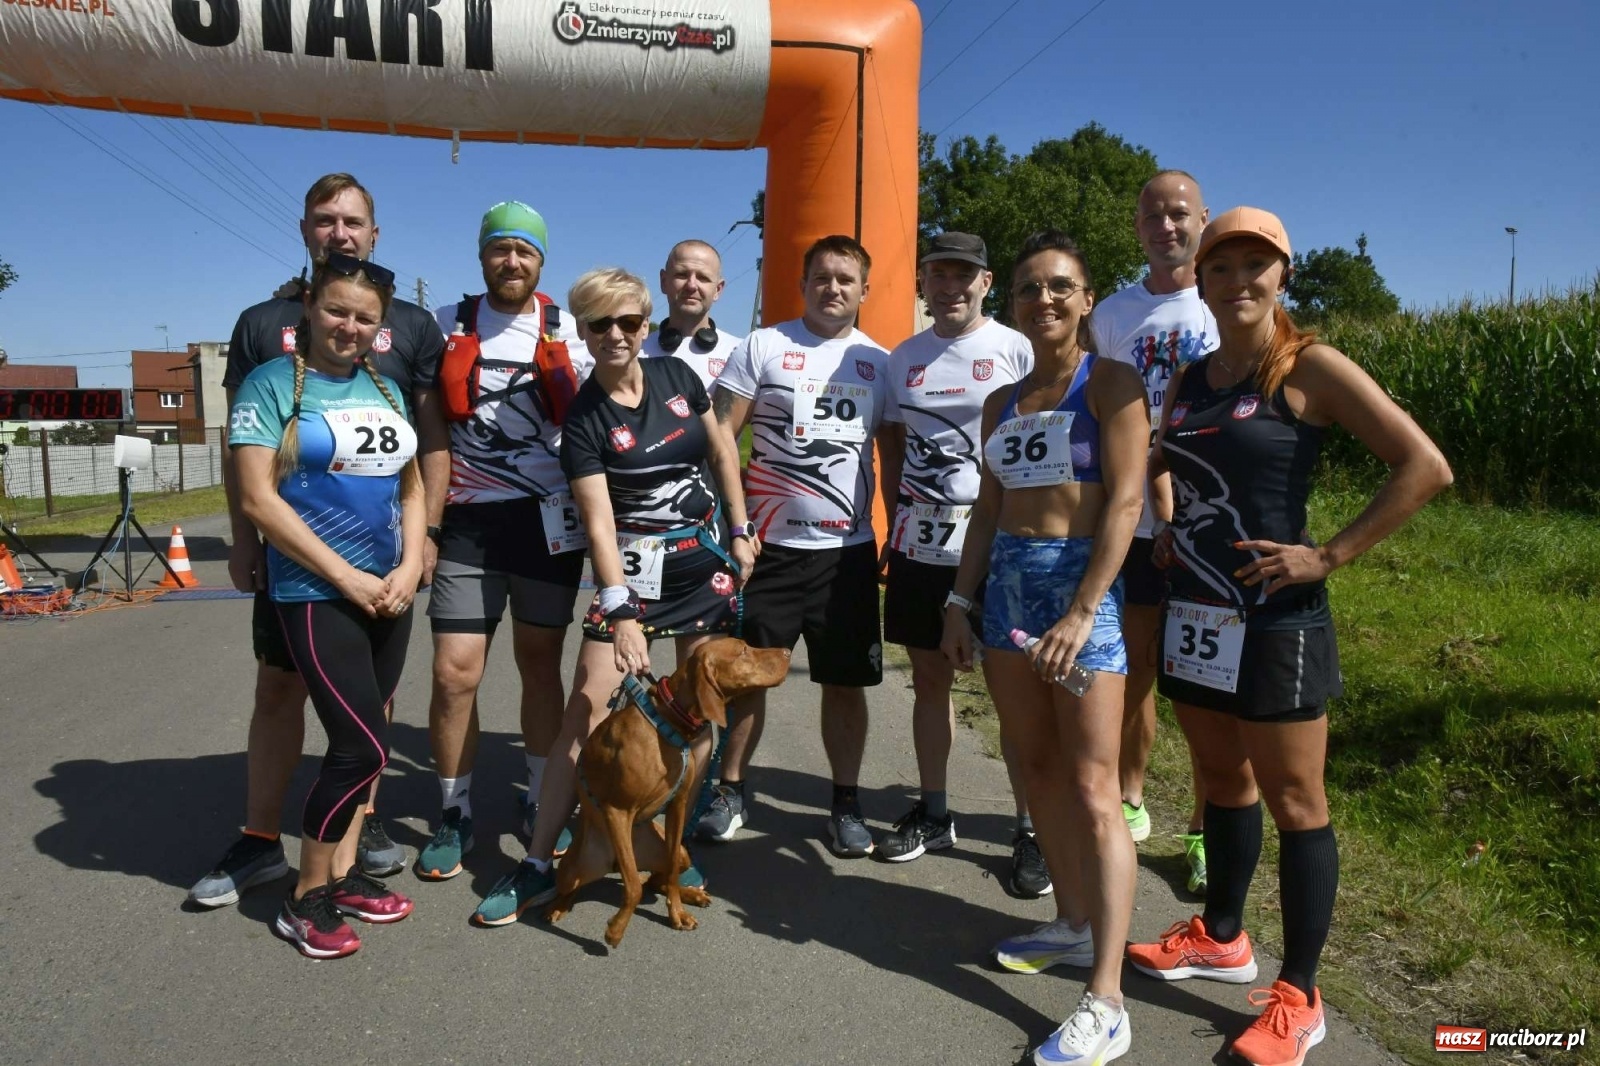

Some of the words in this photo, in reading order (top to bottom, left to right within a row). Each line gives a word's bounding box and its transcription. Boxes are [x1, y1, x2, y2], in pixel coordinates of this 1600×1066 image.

[589, 2, 657, 18] Elektroniczny
[660, 10, 694, 19] pomiar
[697, 12, 725, 21] czasu
[801, 384, 844, 396] COLOUR
[848, 386, 868, 398] RUN
[812, 397, 857, 422] 50
[1040, 415, 1067, 428] RUN
[354, 426, 400, 454] 28
[1001, 431, 1048, 466] 36
[917, 520, 956, 546] 37
[1171, 606, 1209, 625] COLOUR
[1179, 624, 1220, 660] 35
